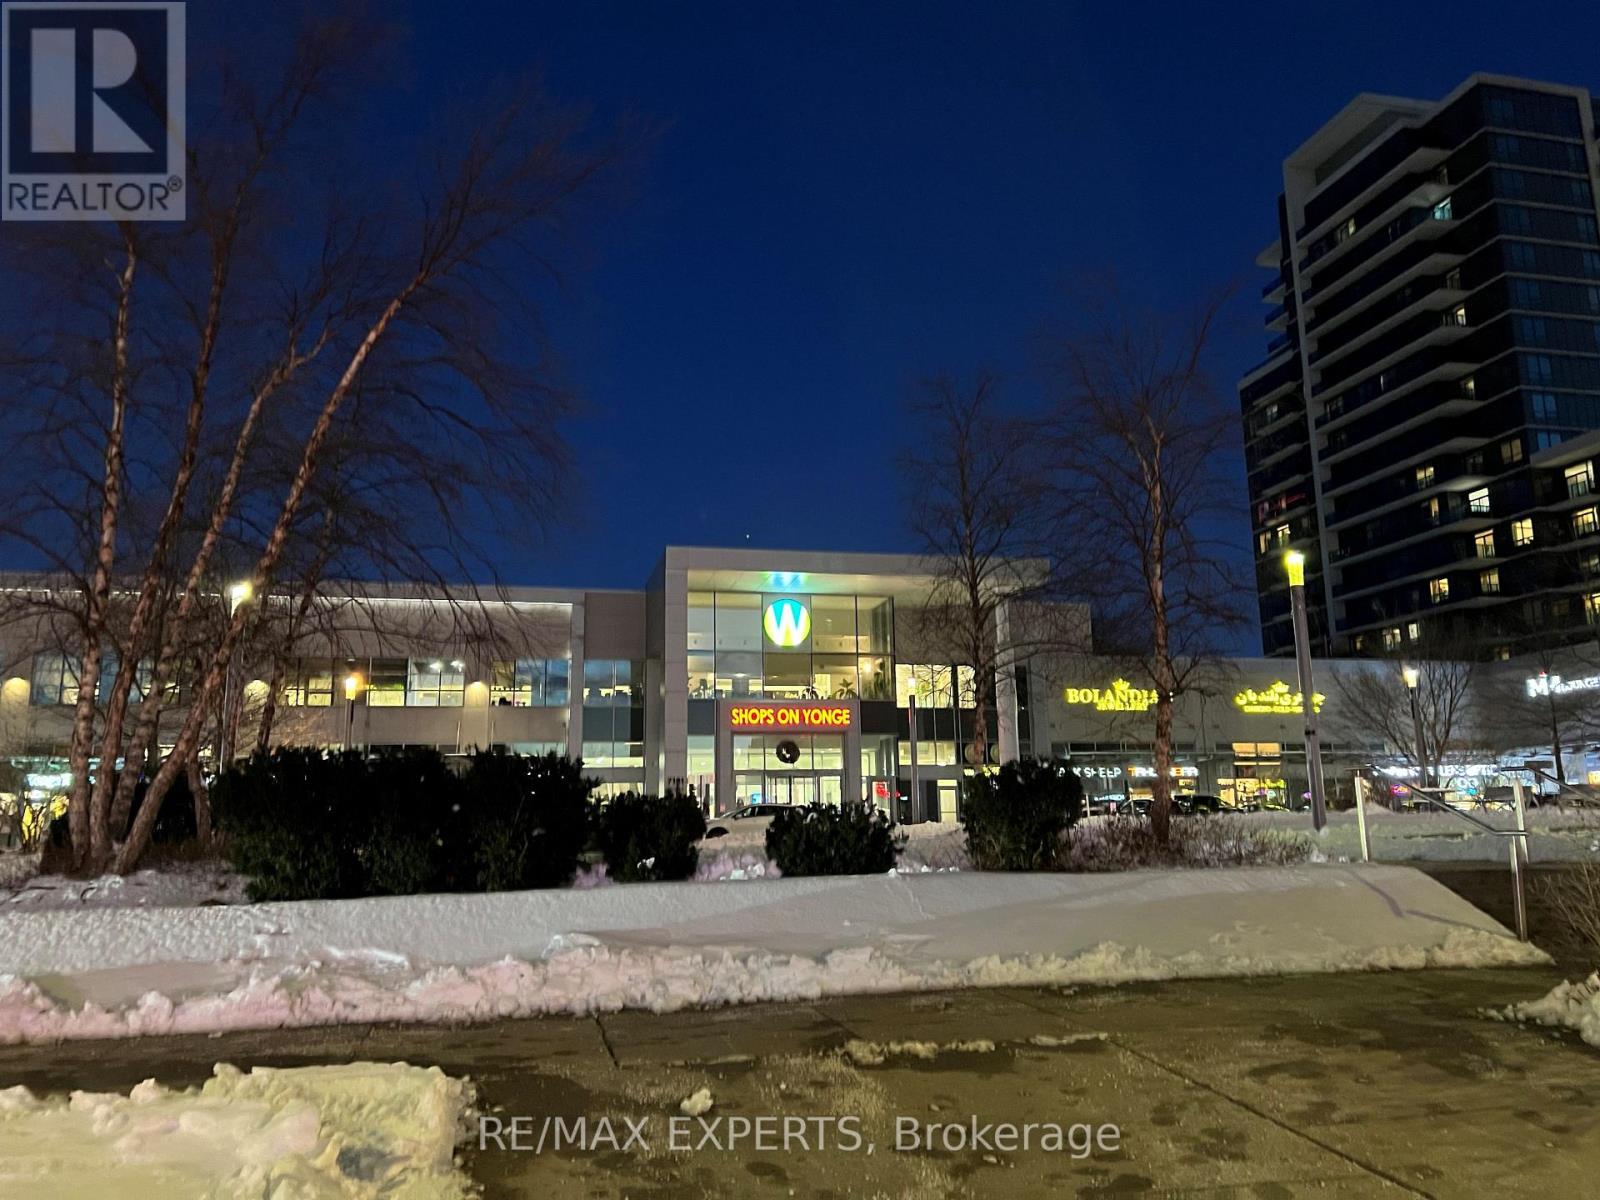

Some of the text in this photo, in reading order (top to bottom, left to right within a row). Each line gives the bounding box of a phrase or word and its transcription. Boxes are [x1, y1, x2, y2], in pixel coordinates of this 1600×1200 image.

[1065, 688, 1173, 704] BOLANDIA
[731, 708, 851, 725] SHOPS ON YONGE
